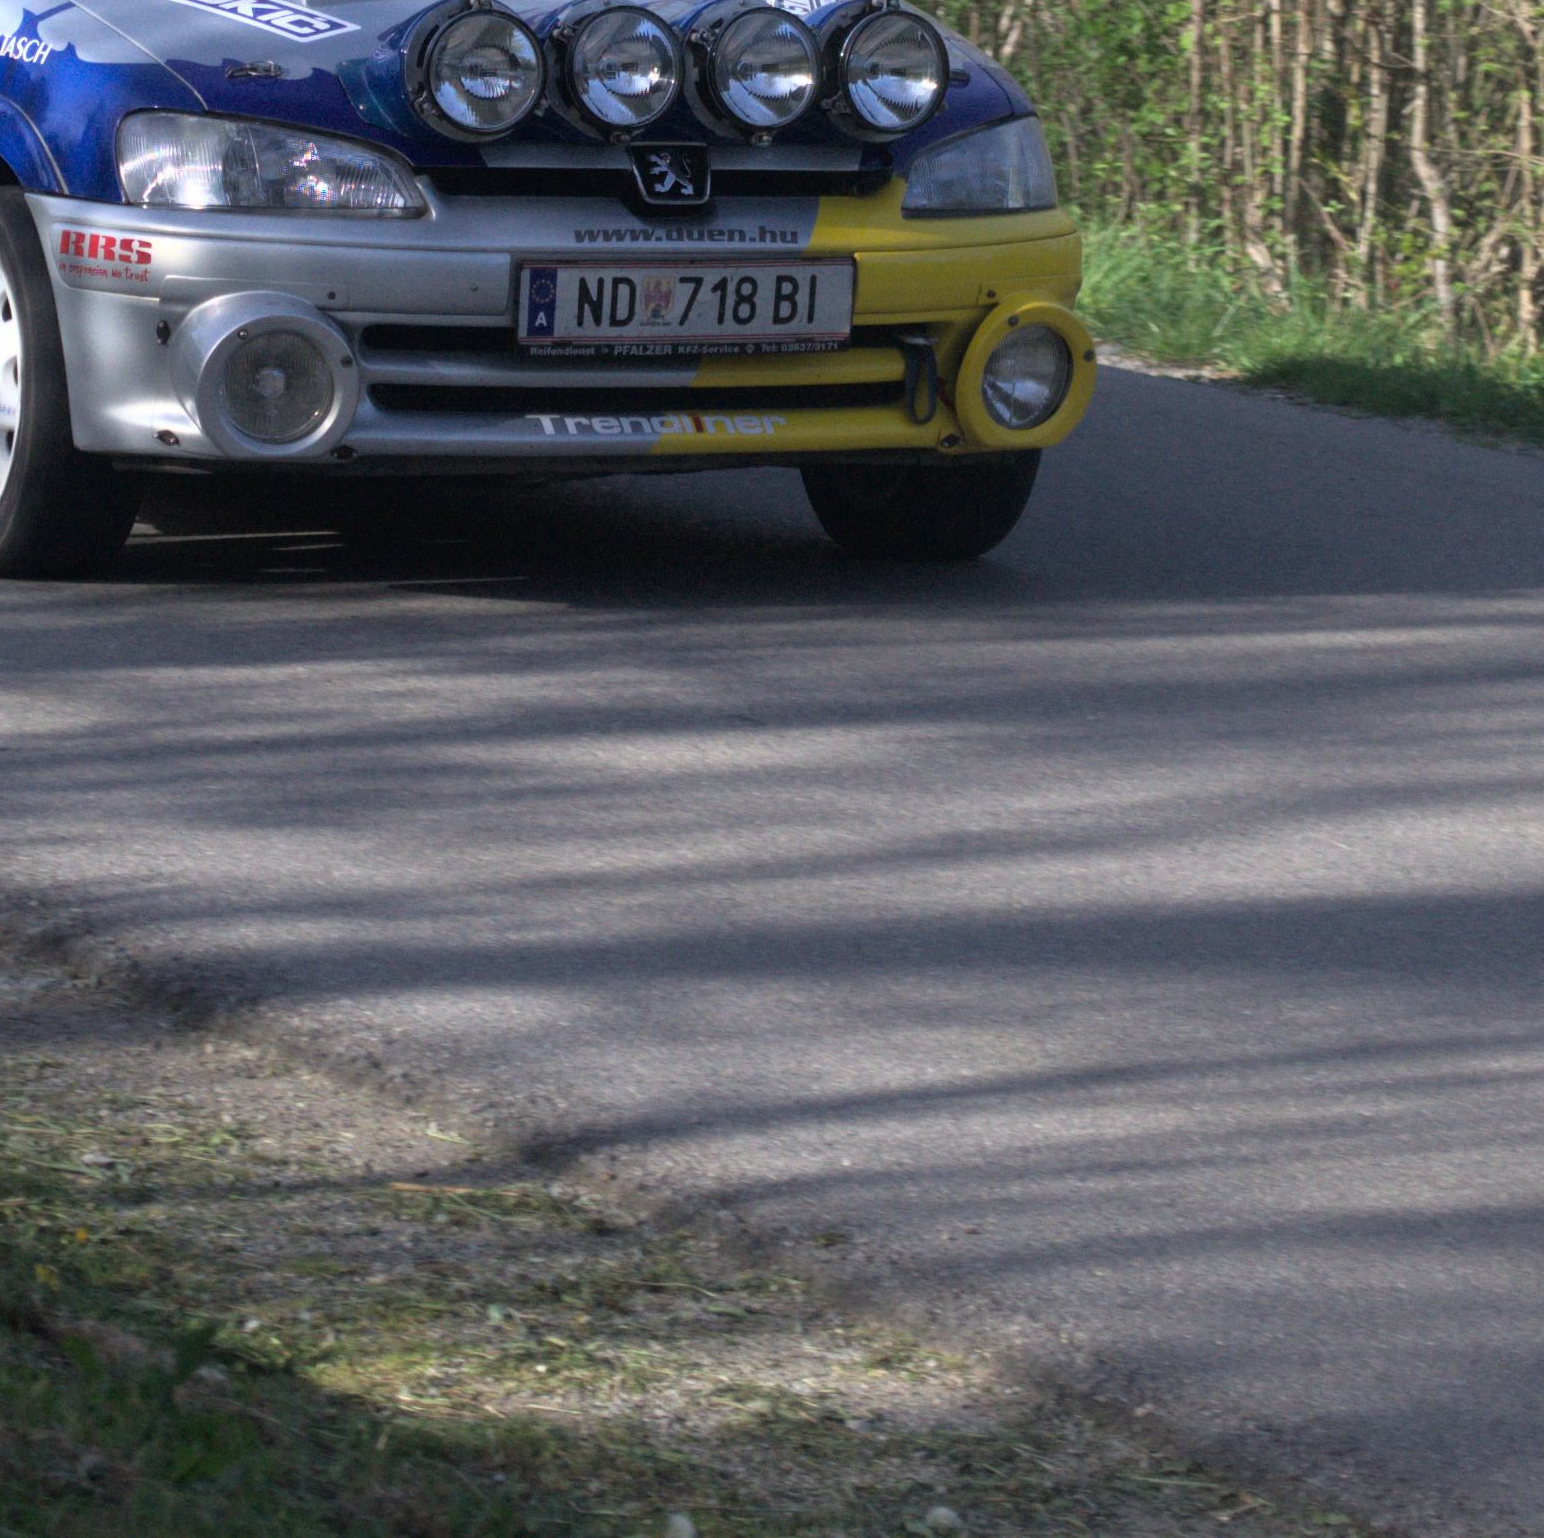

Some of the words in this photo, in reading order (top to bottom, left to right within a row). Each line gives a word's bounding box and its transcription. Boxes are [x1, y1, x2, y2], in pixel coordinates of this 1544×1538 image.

[0, 33, 54, 65] TASCH
[60, 230, 152, 265] RRS
[124, 266, 150, 282] trust
[576, 276, 637, 327] ND
[678, 276, 758, 326] 718
[772, 274, 817, 325] BI
[534, 311, 548, 327] A
[525, 413, 786, 435] Trendliner
